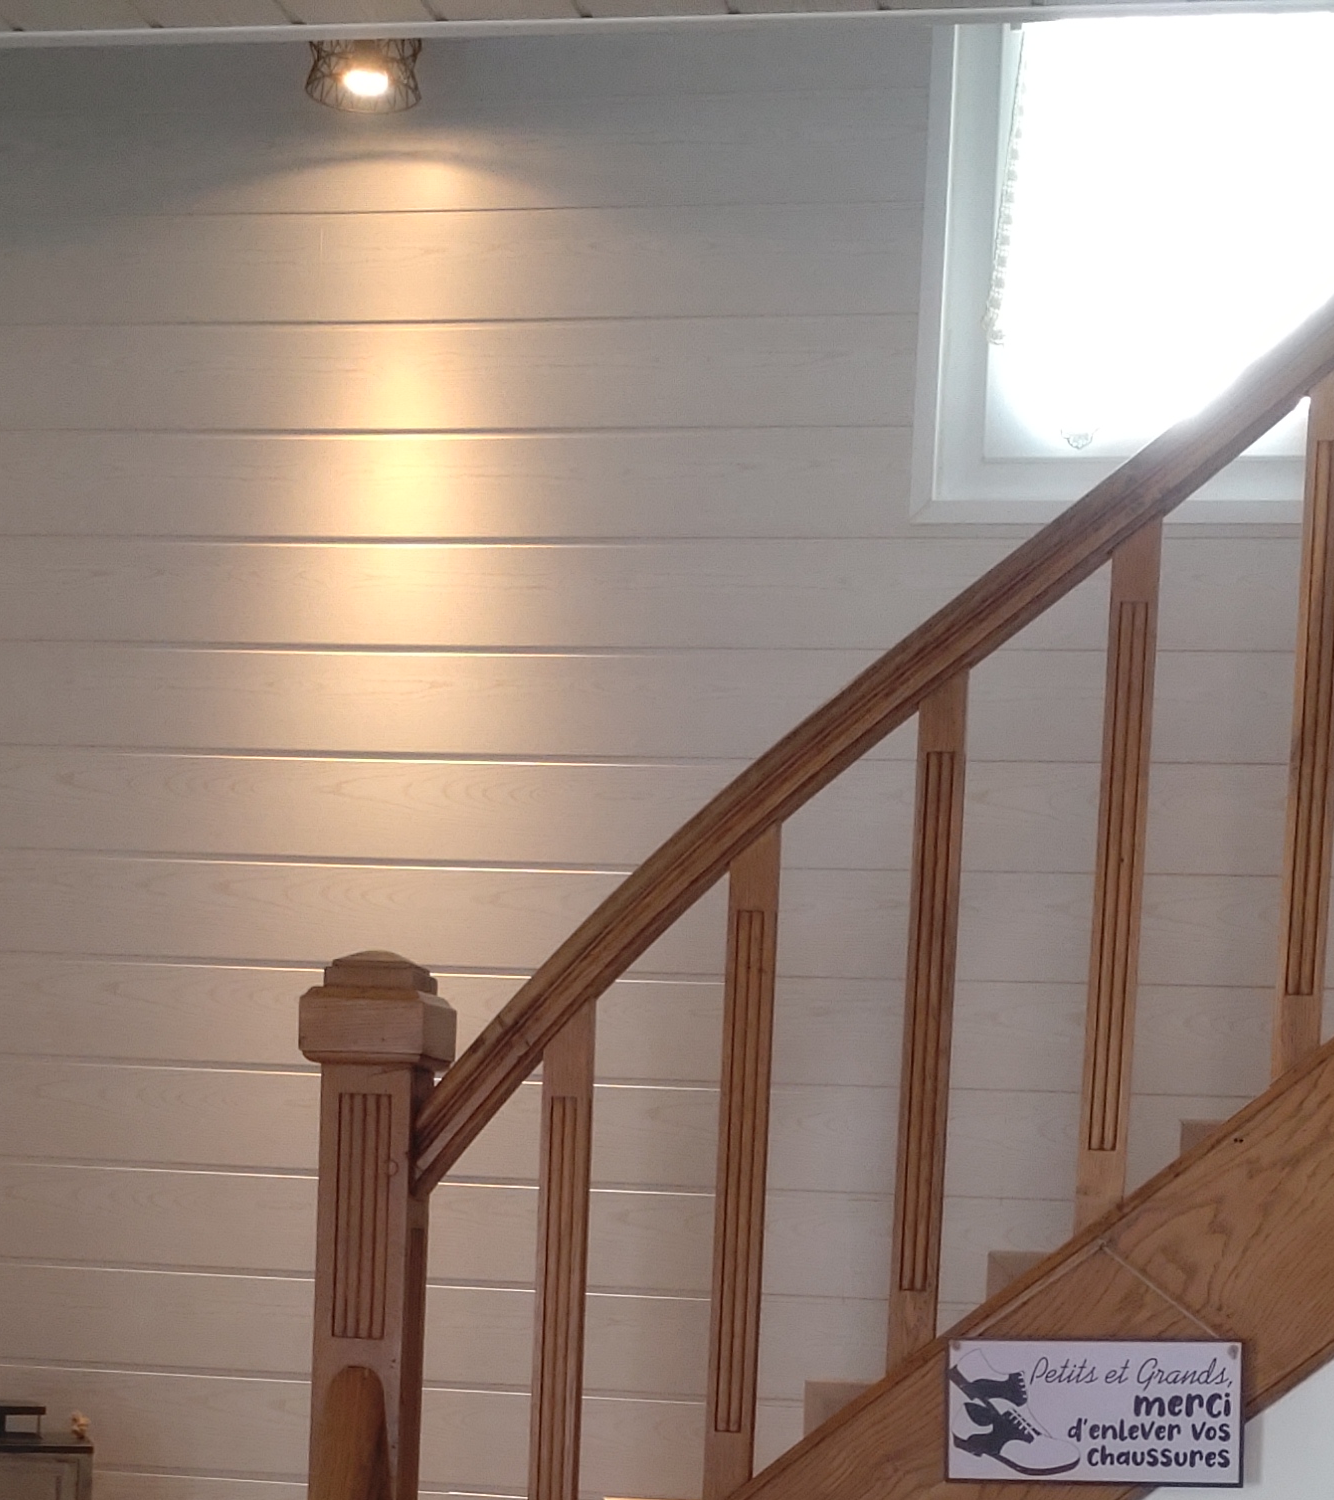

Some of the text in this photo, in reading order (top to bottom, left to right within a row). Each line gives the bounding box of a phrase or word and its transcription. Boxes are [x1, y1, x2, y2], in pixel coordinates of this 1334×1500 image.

[1029, 1356, 1234, 1391] Petits et Grands,
[1133, 1392, 1232, 1418] merci
[1067, 1418, 1182, 1443] d'enlever
[1086, 1445, 1231, 1468] chaussures
